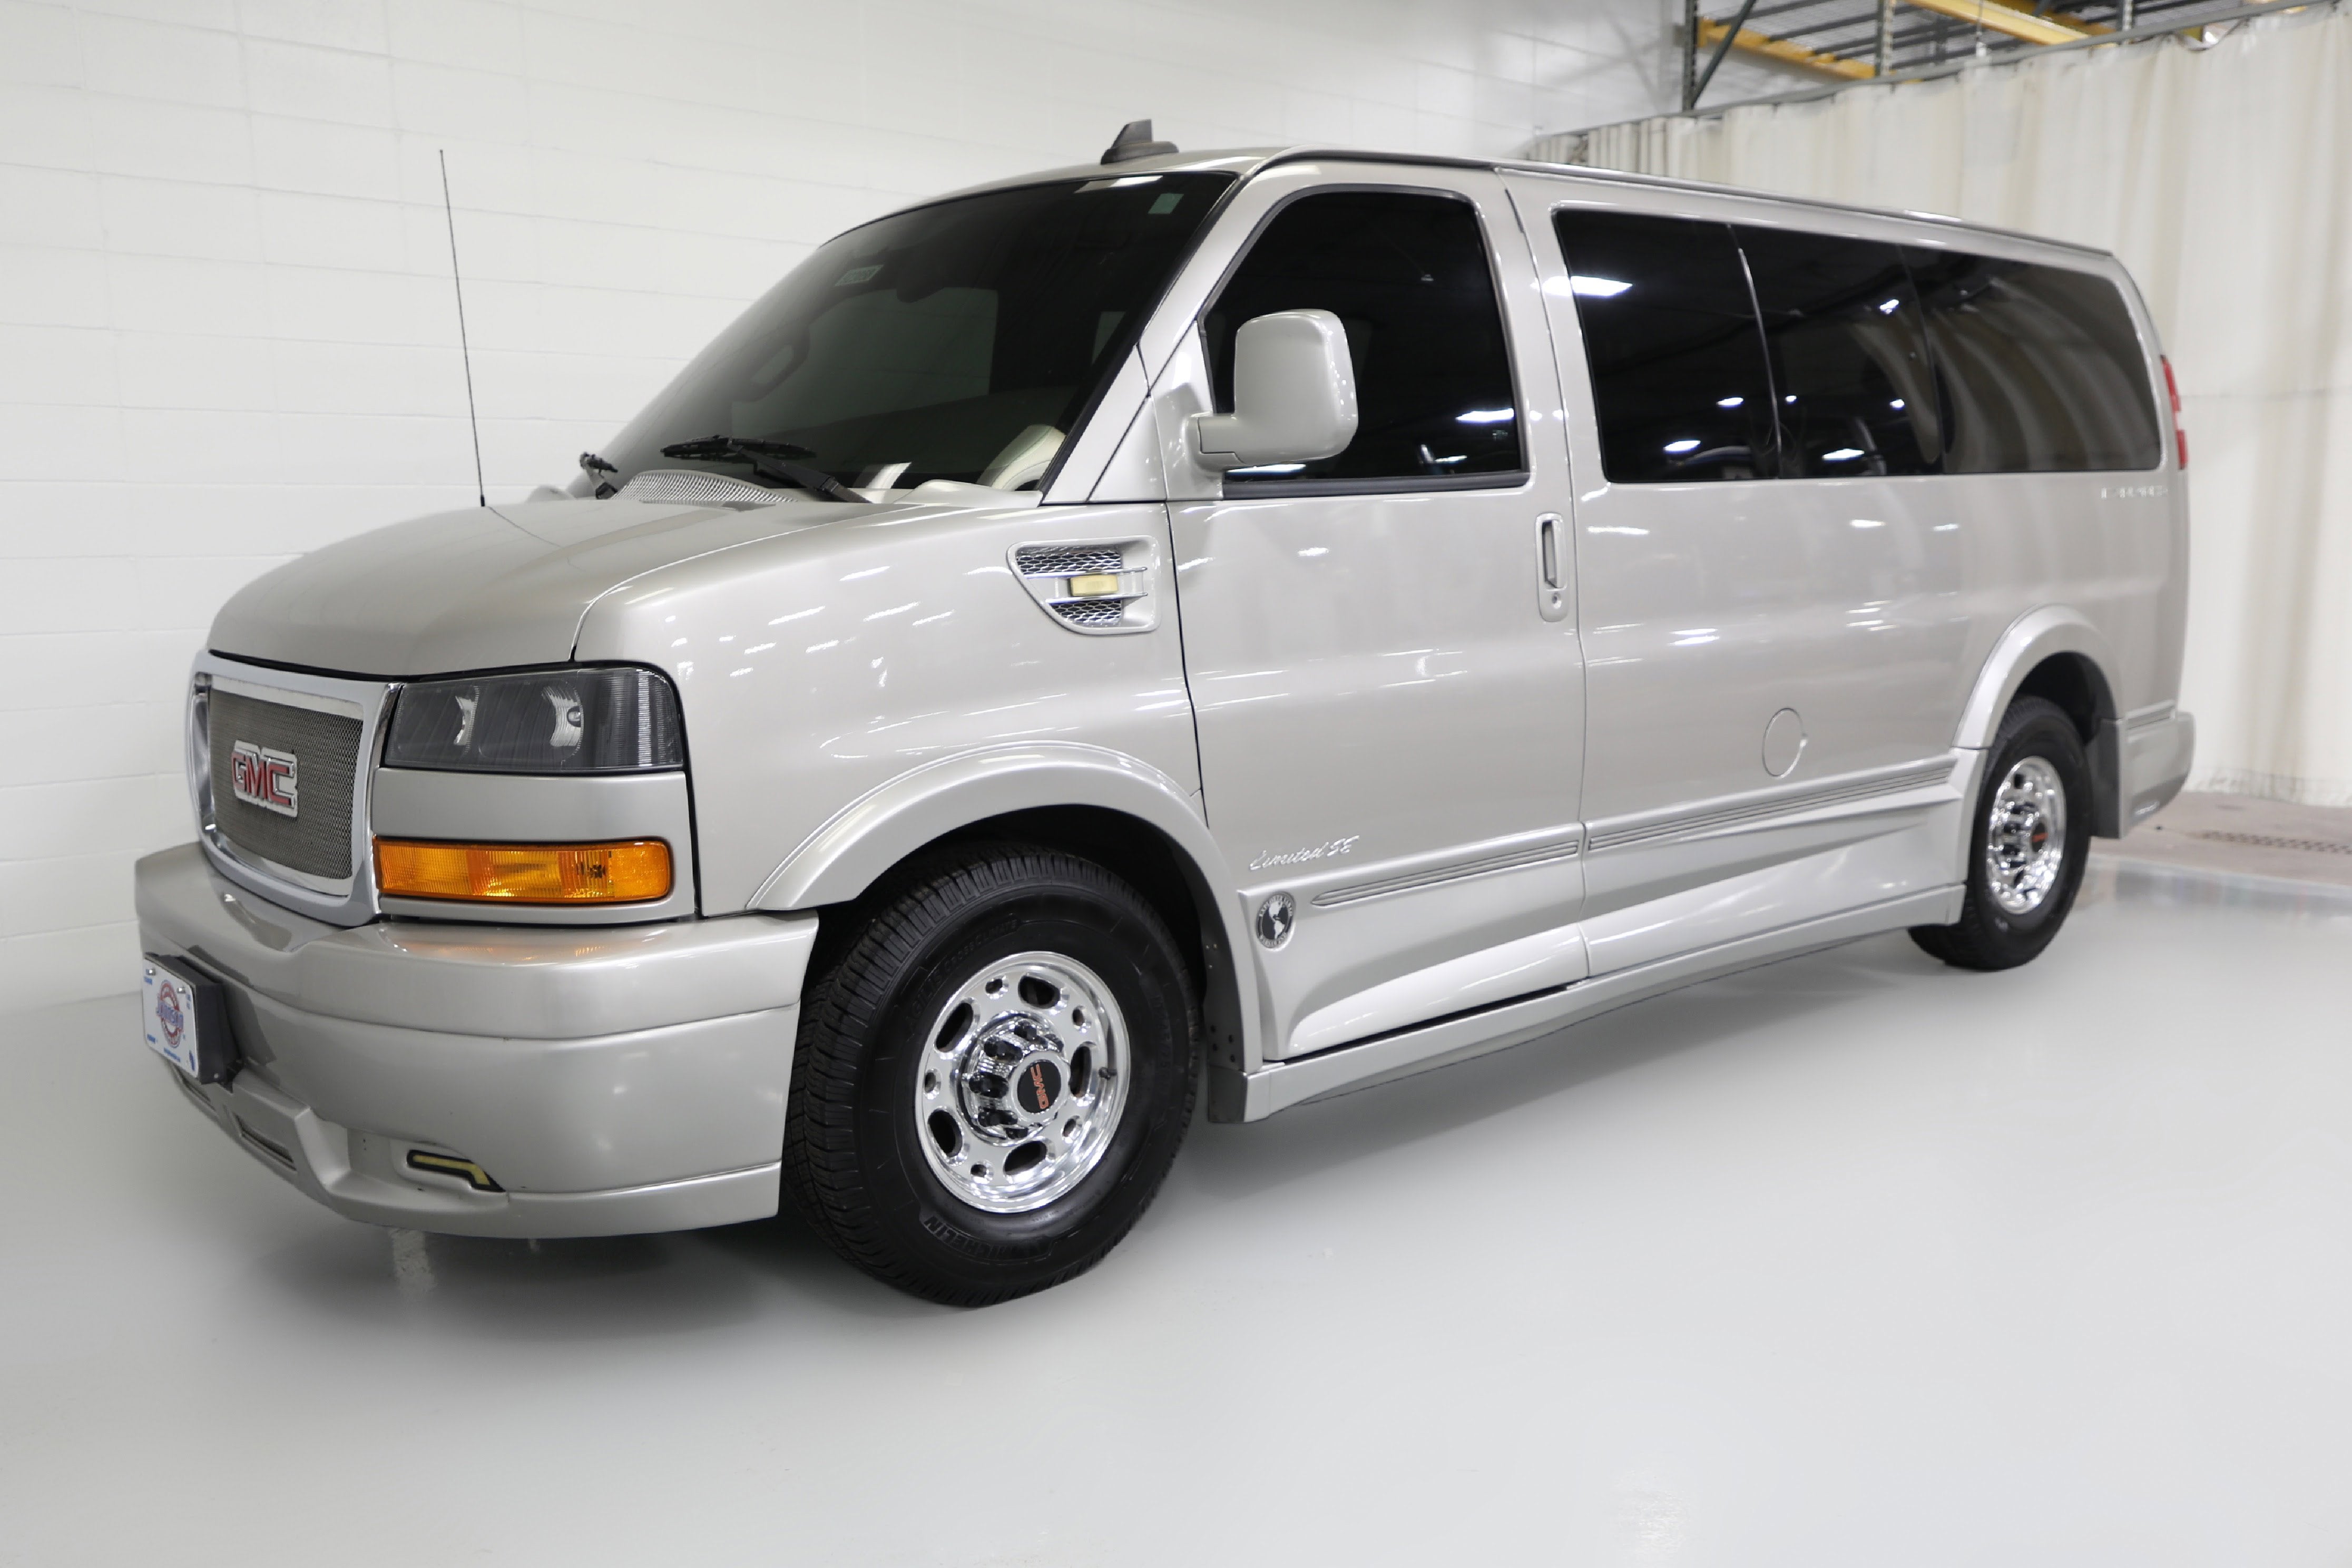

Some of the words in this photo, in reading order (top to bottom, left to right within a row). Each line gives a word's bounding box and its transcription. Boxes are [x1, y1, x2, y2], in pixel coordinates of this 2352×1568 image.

[231, 748, 296, 810] GMC
[1249, 842, 1329, 870] Limited
[1327, 835, 1359, 857] SE
[1030, 1063, 1049, 1109] GMC
